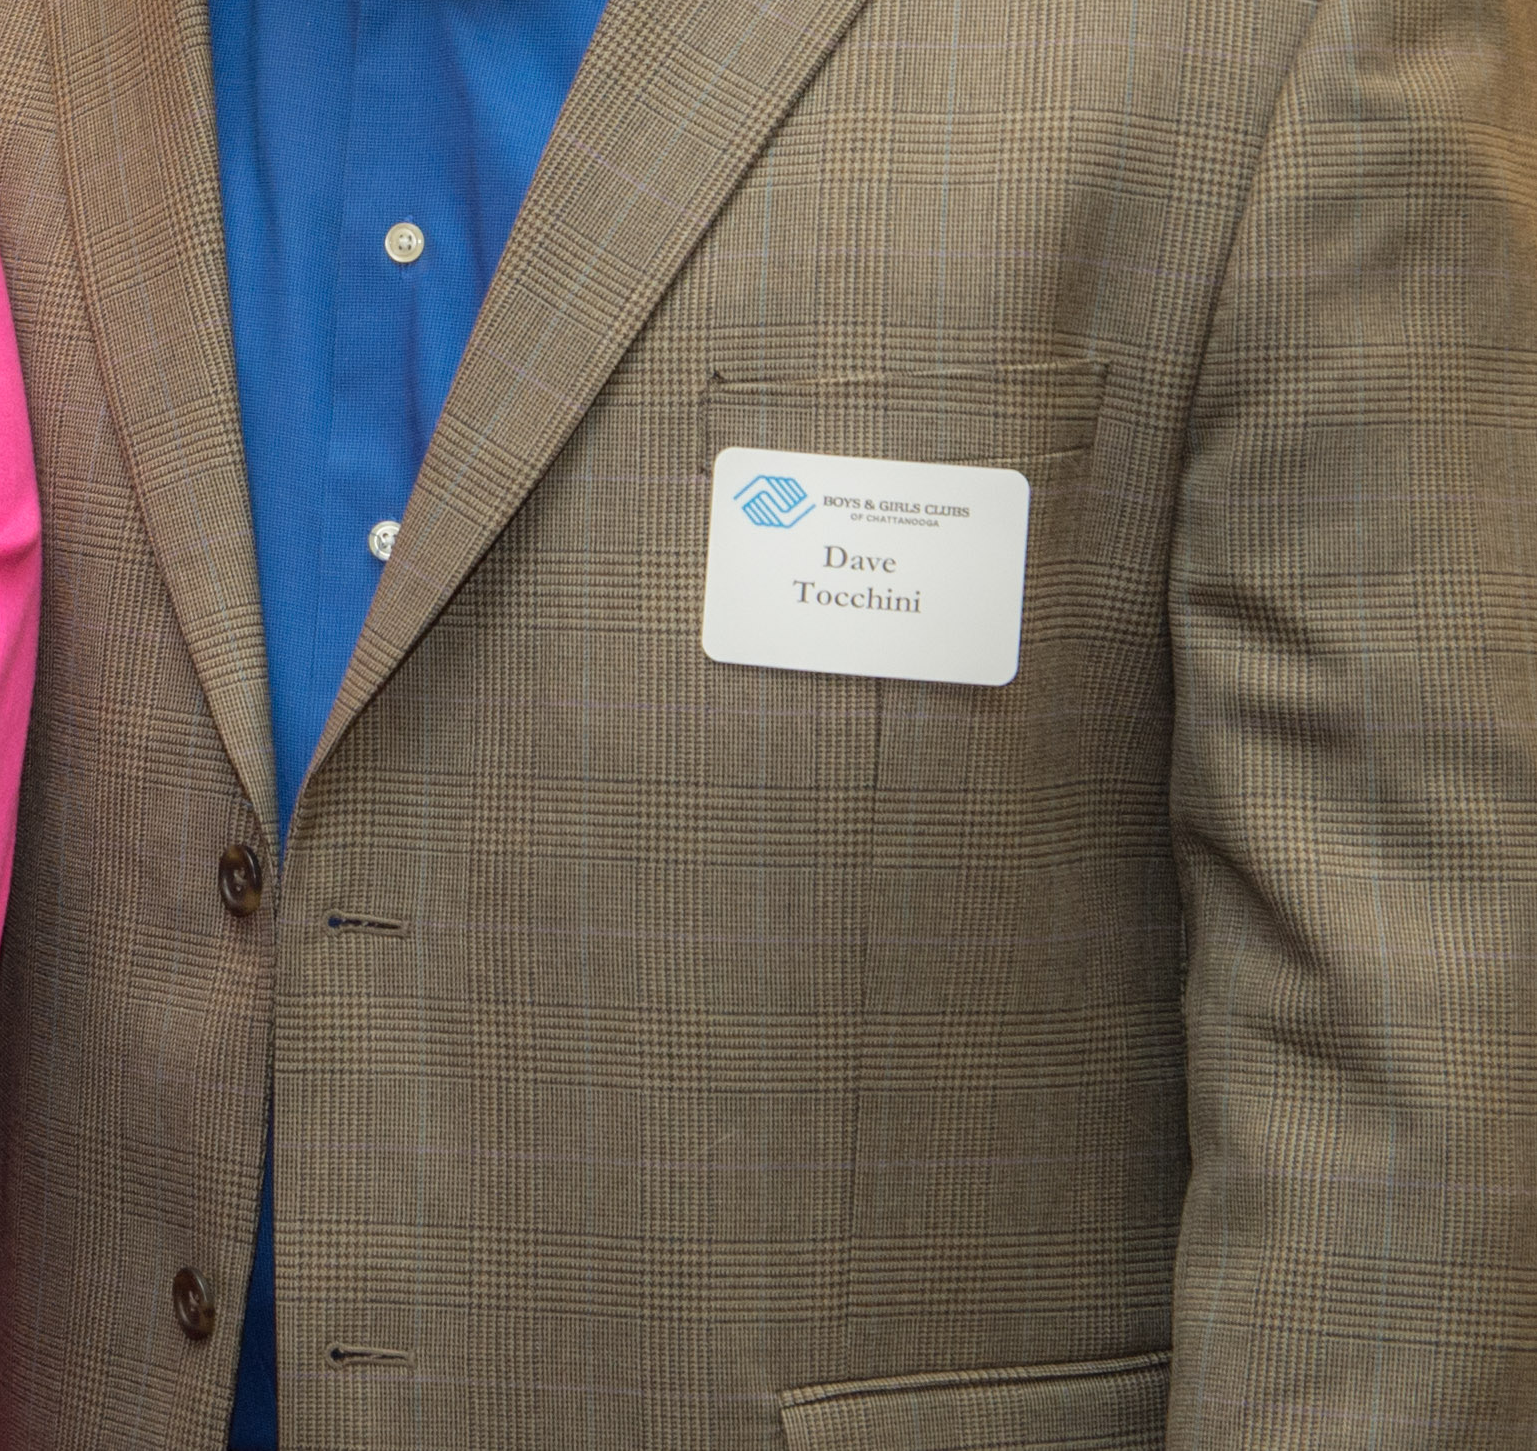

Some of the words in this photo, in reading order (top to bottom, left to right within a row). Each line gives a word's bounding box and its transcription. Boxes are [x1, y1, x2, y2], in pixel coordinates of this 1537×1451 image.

[823, 495, 861, 509] BOYS
[864, 499, 875, 511] &
[879, 500, 921, 514] GIRLS
[924, 504, 970, 518] CLUBS
[850, 513, 864, 521] OF
[866, 514, 940, 528] CHATTANOOGA
[822, 545, 897, 574] Dave
[792, 579, 922, 614] Tocchini
